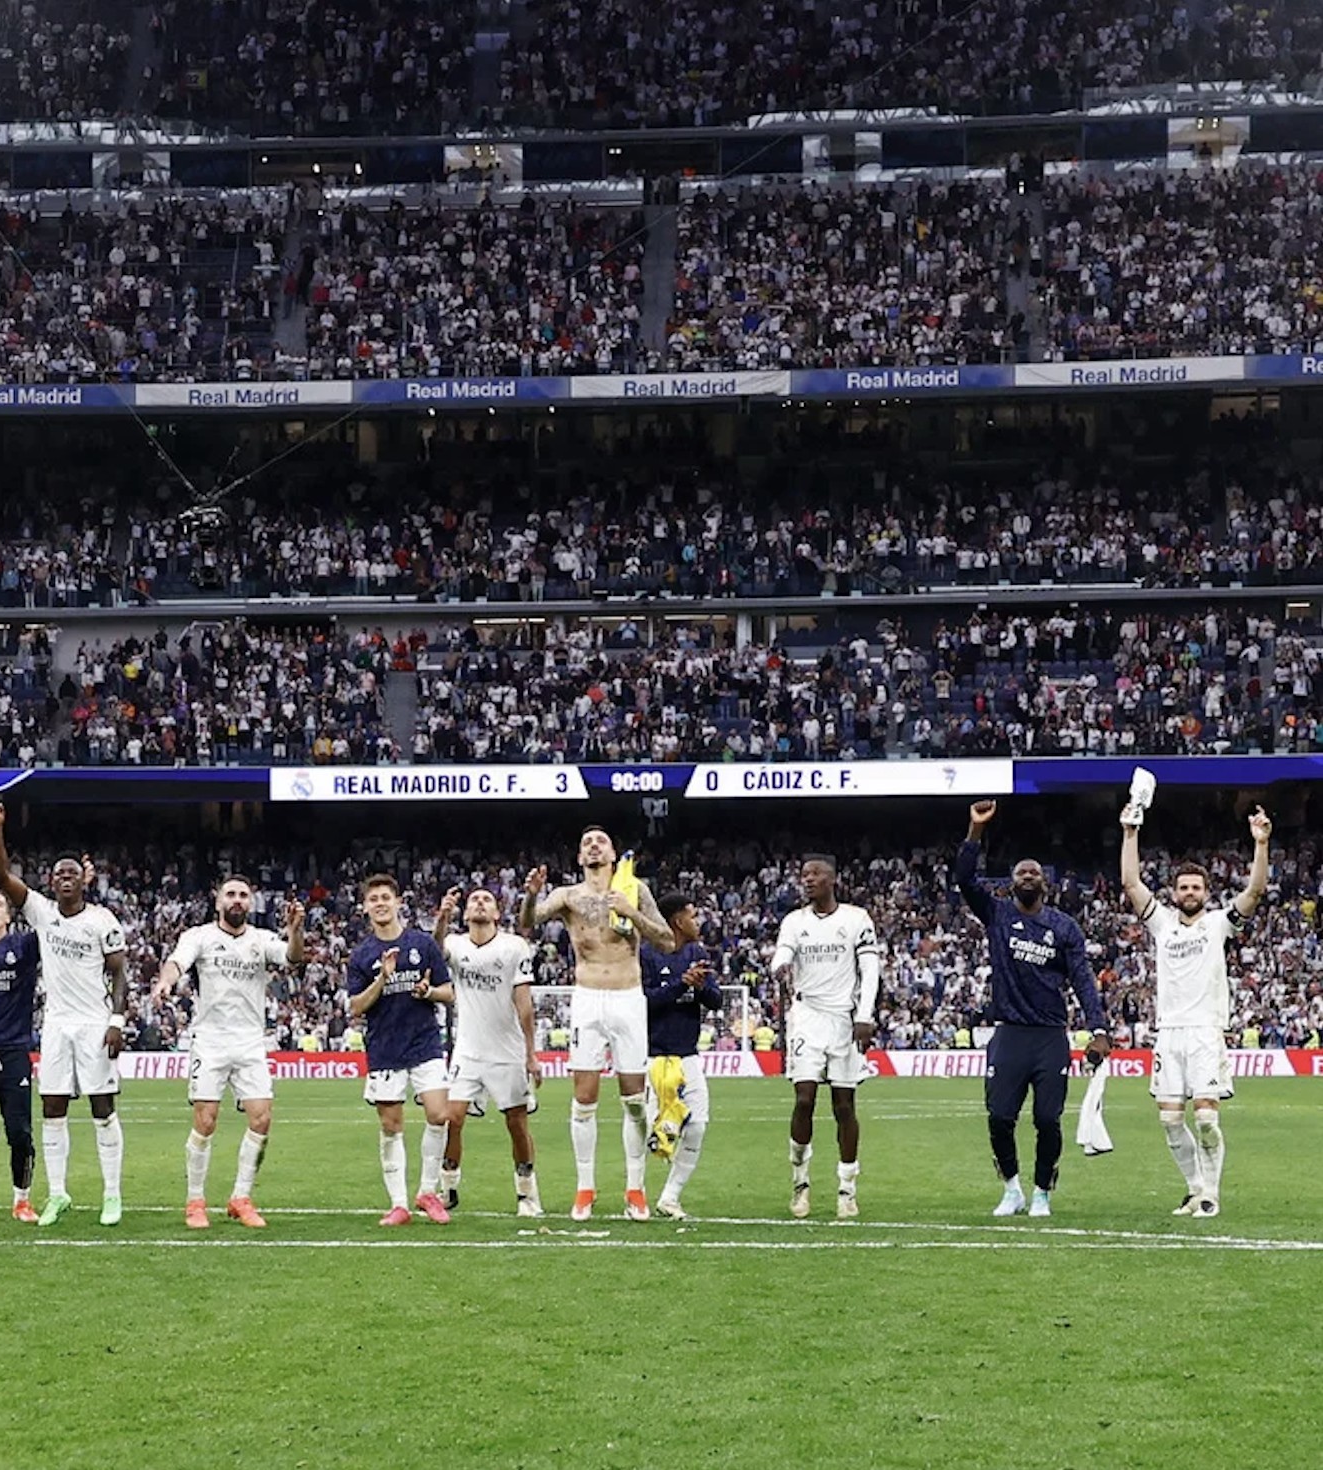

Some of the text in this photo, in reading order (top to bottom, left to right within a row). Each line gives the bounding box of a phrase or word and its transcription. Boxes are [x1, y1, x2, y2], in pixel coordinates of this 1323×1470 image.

[847, 370, 959, 388] Real Madrid
[1071, 365, 1187, 383] Real Madrid
[18, 388, 82, 404] Madrid
[189, 388, 299, 404] Real Madrid
[406, 381, 516, 399] Real Madrid
[624, 379, 736, 396] Real Madrid
[334, 774, 525, 794] REAL MADRID C. F.
[555, 773, 567, 793] 3
[611, 771, 663, 791] 90:00
[706, 771, 718, 790] 0
[744, 766, 858, 790] CÁDIZ C. F.
[46, 931, 92, 952] Emirates
[799, 943, 847, 955] Emirates
[1009, 936, 1057, 958] Emirates
[214, 956, 260, 971] Emirates
[135, 1056, 159, 1078] FLY
[191, 1059, 202, 1079] 2
[266, 1058, 359, 1079] Emirates
[702, 1055, 741, 1074] TTER
[912, 1055, 986, 1076] FLY BETT
[1232, 1054, 1274, 1076] TTER
